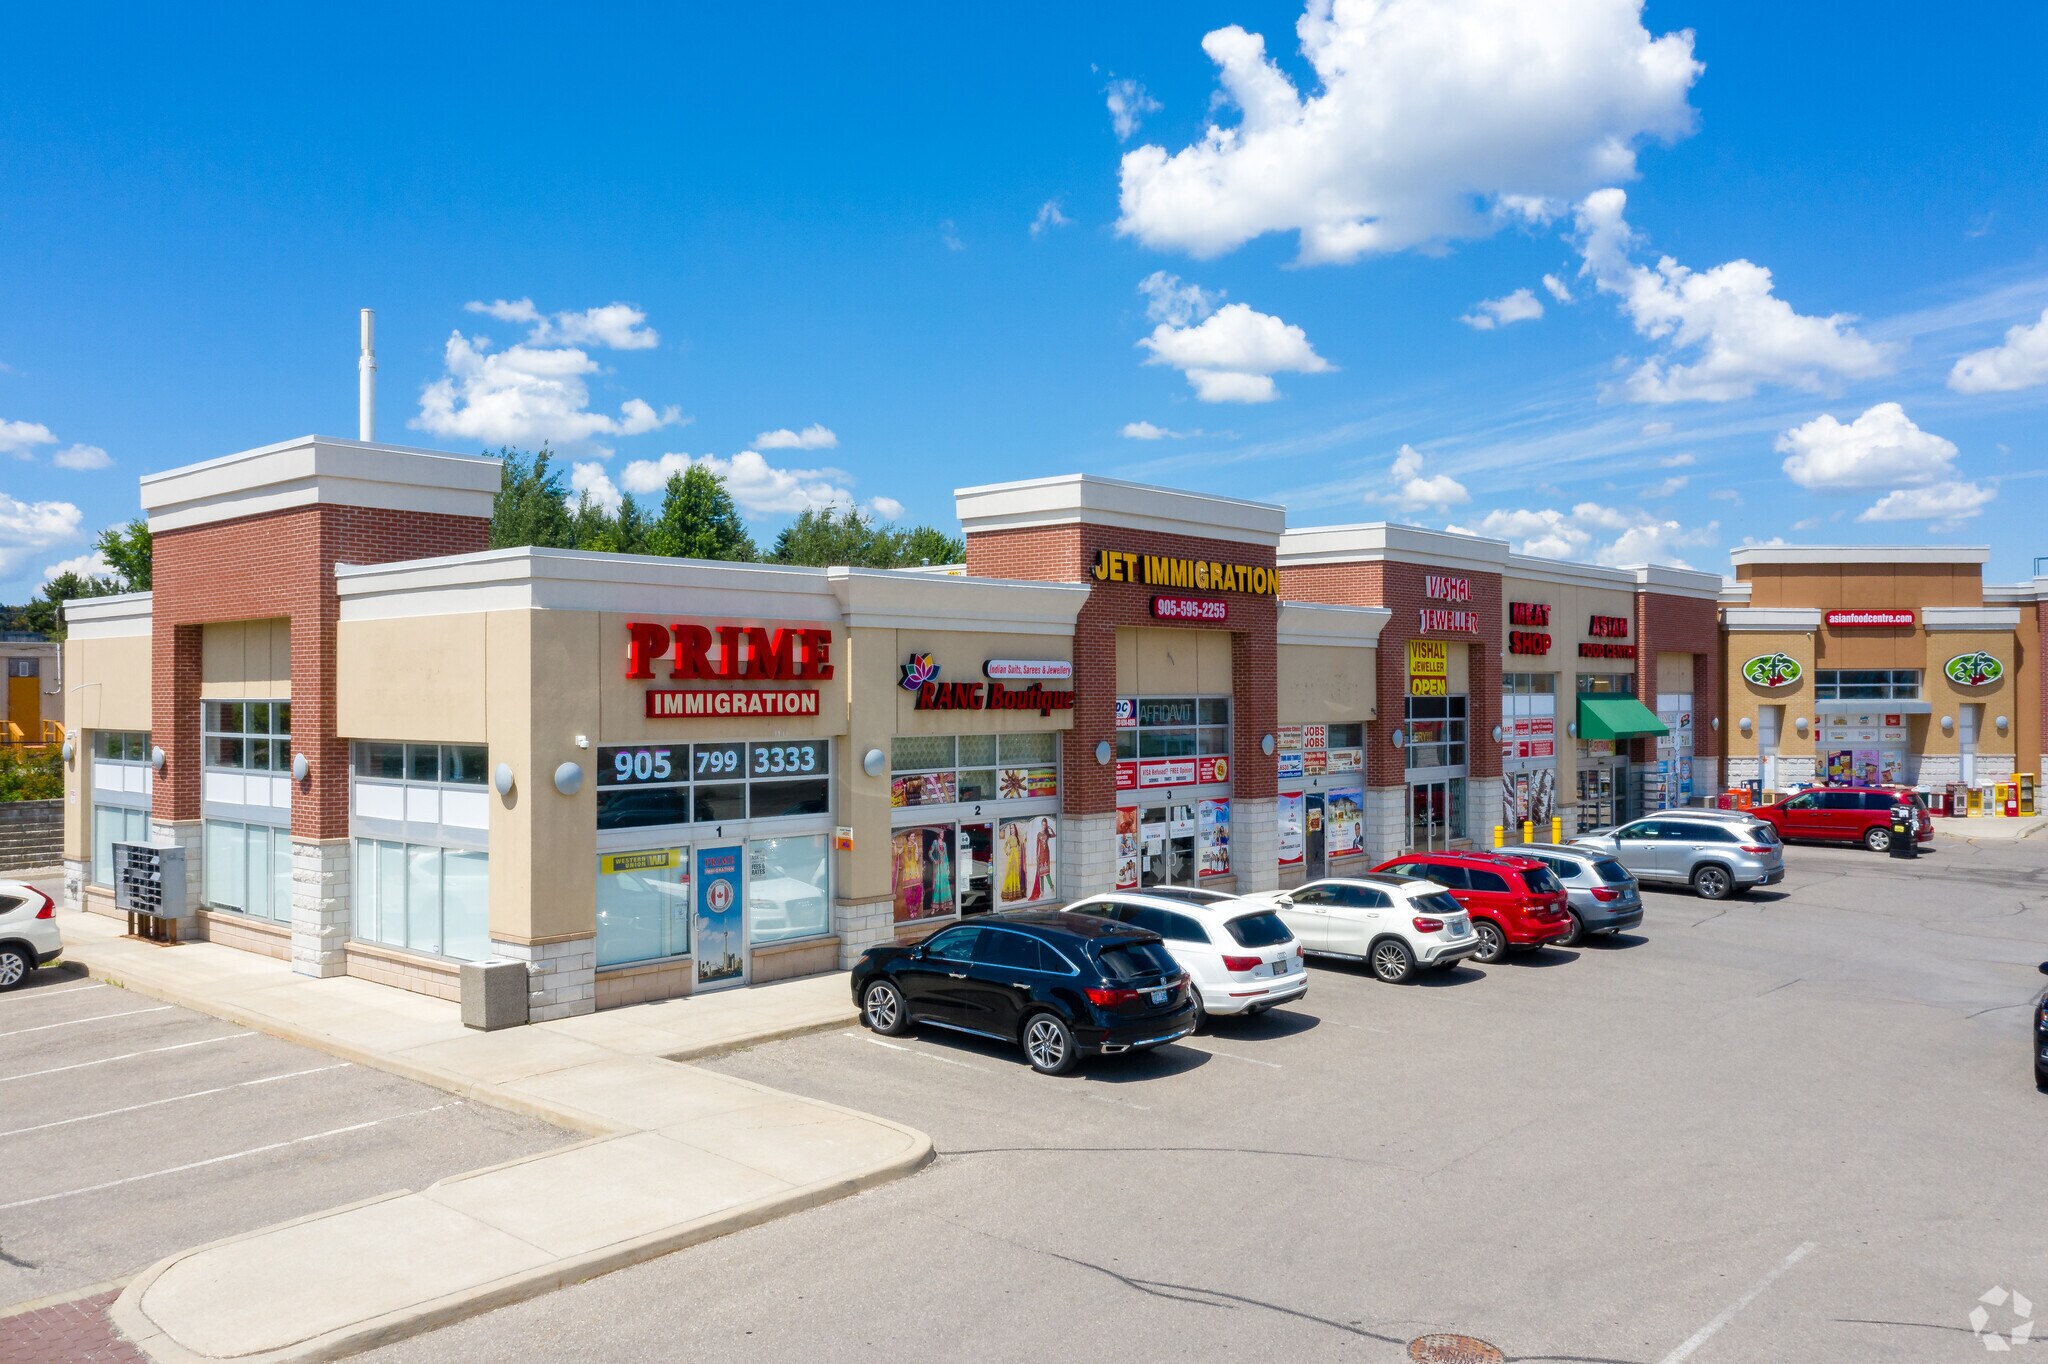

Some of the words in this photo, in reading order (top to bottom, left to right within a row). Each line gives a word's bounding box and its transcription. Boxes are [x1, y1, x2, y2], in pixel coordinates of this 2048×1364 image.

[1091, 550, 1137, 582] JET
[1142, 555, 1279, 595] IMMIGRATION
[1426, 576, 1473, 601] VISHAL
[1158, 598, 1226, 618] 905-595-2255
[1510, 602, 1551, 626] MEAT
[1420, 610, 1478, 633] JEWELLER
[1589, 615, 1628, 637] ASIAN
[1829, 613, 1912, 623] asianfoodcentre.com
[626, 622, 834, 680] PRIME
[1411, 642, 1445, 659] VISHAL
[1509, 631, 1552, 655] SHOP
[1580, 643, 1604, 657] FOOD
[989, 664, 1006, 674] Indian
[1008, 665, 1022, 675] Suits,
[1023, 665, 1041, 674] Sarees
[1042, 666, 1046, 674] &
[1047, 665, 1071, 677] Jewellery
[1412, 661, 1445, 673] JEWELLER
[1411, 679, 1447, 695] OPEN
[654, 693, 816, 715] IMMIGRATION
[915, 682, 984, 710] RANG
[985, 682, 1075, 717] Boutique
[1140, 703, 1192, 722] AFFIDAVIT
[1304, 727, 1325, 737] JOBS
[1304, 738, 1325, 748] JOBS
[614, 750, 672, 781] 905
[696, 751, 738, 774] 799
[754, 746, 815, 773] 3333
[1167, 790, 1172, 799] 3
[975, 805, 981, 815] 2
[716, 826, 722, 838] 1
[615, 856, 646, 864] WESTERN
[649, 853, 666, 866] WU
[625, 861, 646, 869] UNION
[704, 856, 734, 867] PRIME
